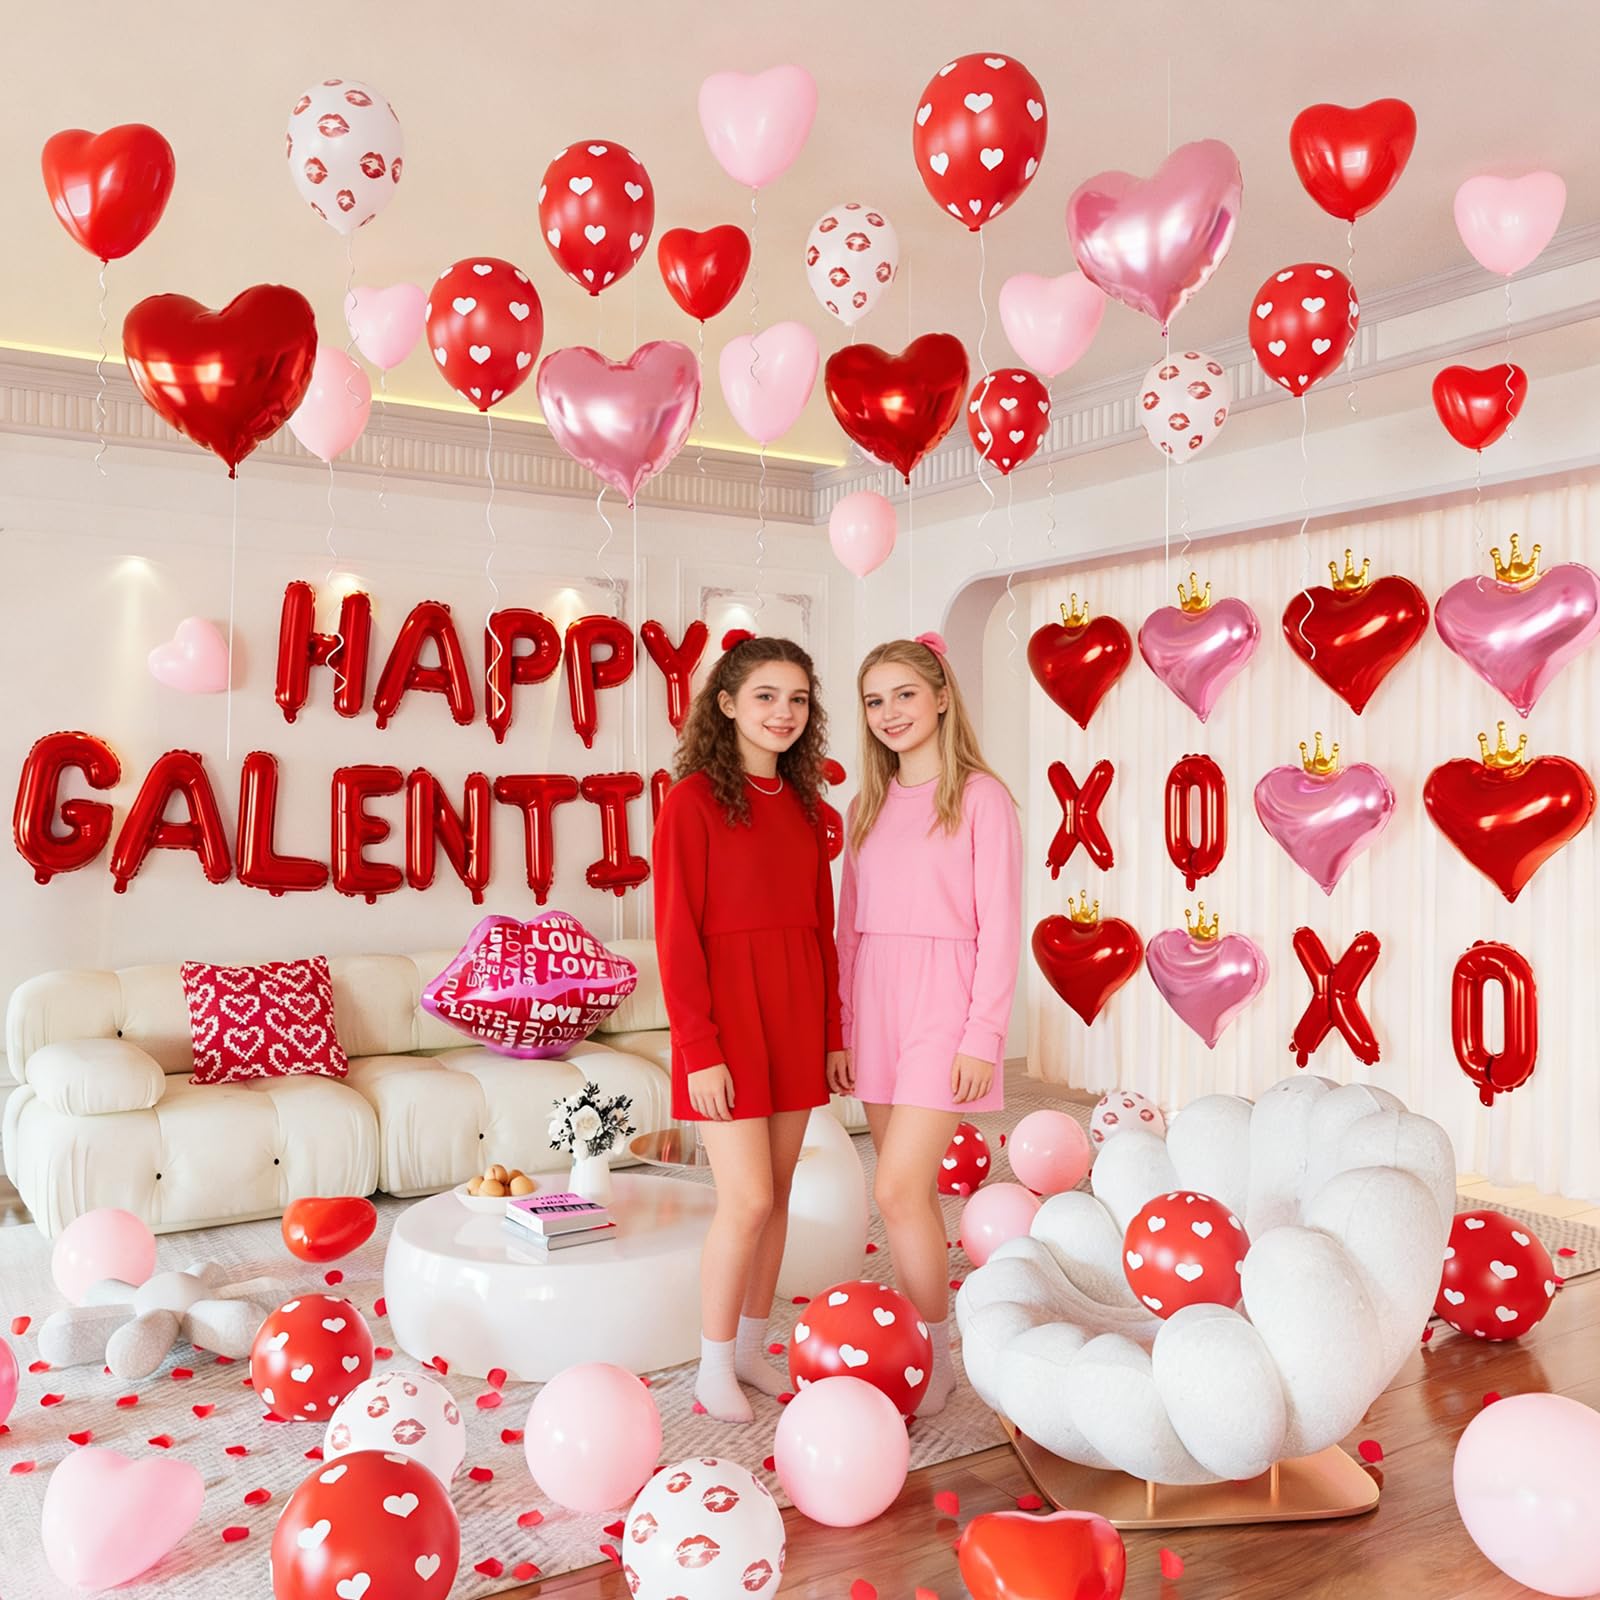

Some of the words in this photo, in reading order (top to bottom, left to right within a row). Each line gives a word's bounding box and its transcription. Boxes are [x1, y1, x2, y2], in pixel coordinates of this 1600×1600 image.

[275, 580, 709, 748] HAPPY
[13, 730, 673, 905] GALENTI
[530, 999, 582, 1024] LOVE
[548, 953, 608, 978] LOVE
